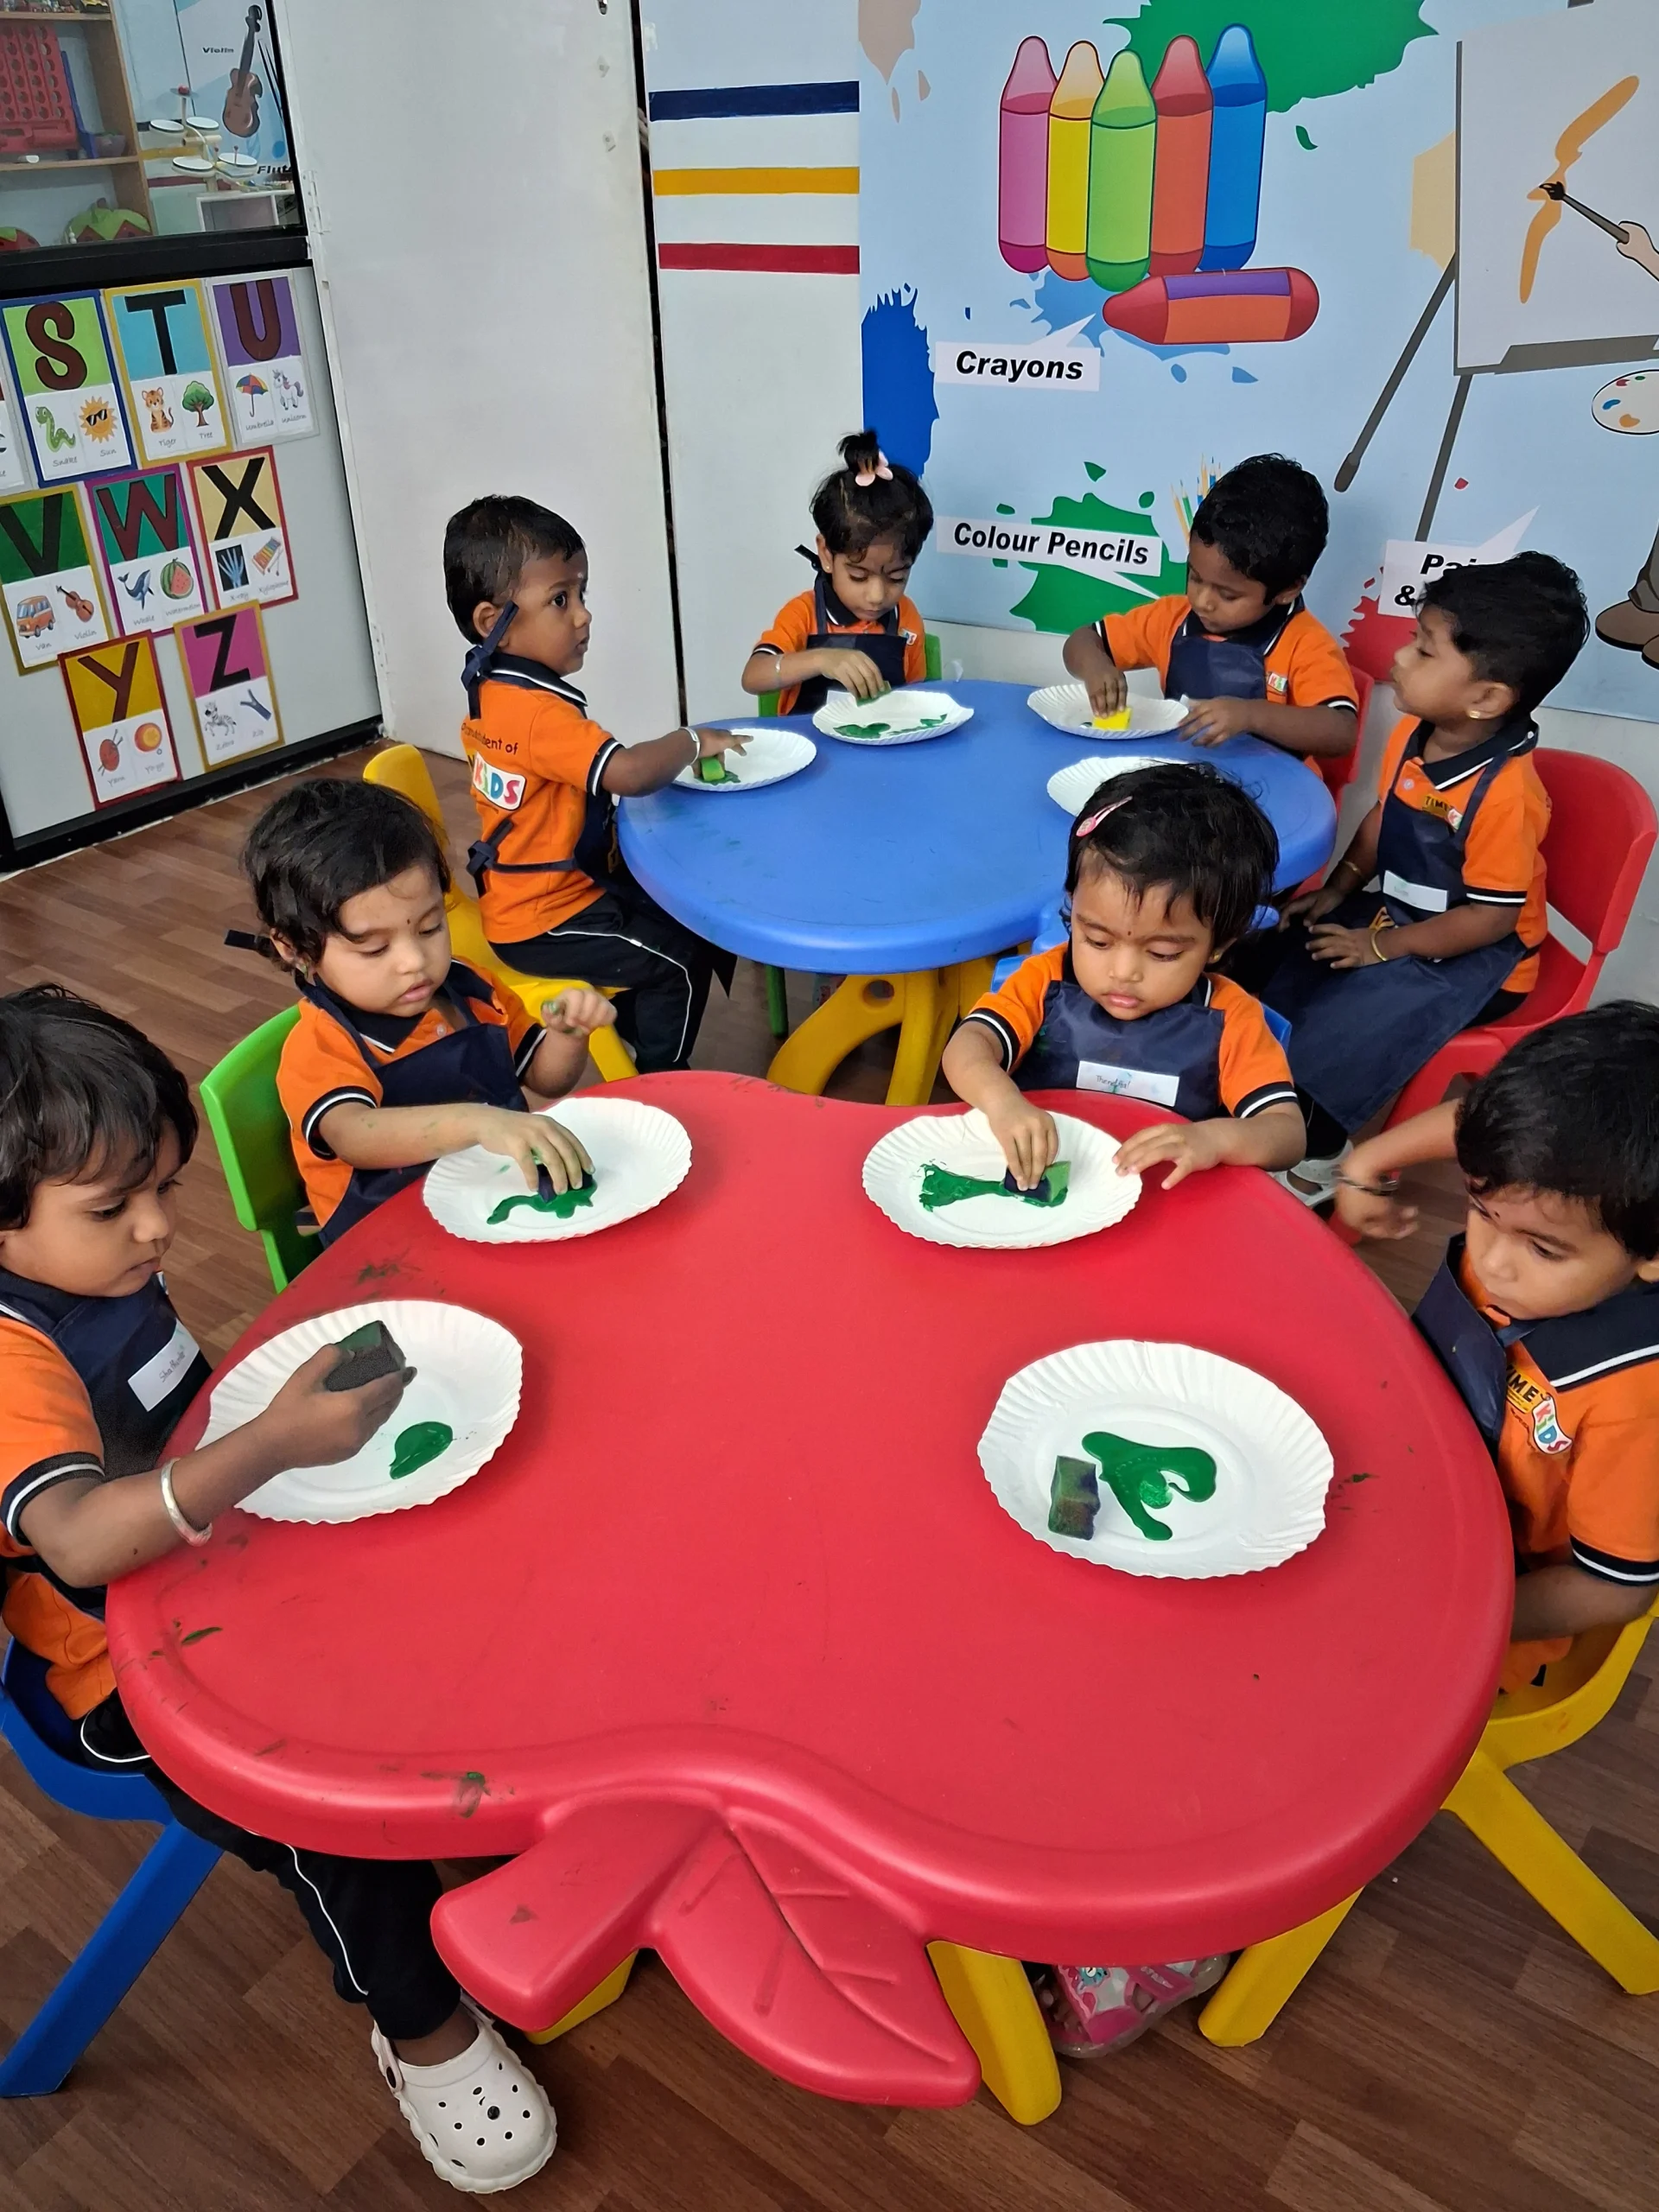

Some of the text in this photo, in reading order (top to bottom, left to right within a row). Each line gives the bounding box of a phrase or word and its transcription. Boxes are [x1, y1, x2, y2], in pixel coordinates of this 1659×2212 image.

[25, 301, 88, 391] S
[124, 289, 187, 375] T
[229, 279, 282, 362] U
[956, 350, 1084, 383] Crayons
[53, 456, 78, 467] Snake
[99, 448, 117, 457] Sun
[158, 438, 176, 448] Tiger
[96, 474, 178, 562] W
[201, 456, 276, 540] X
[0, 493, 63, 577] V
[954, 522, 1148, 565] Colour Pencils
[1394, 585, 1415, 606] &
[74, 630, 97, 640] Violin
[194, 613, 251, 692] Z
[77, 641, 140, 722] Y
[505, 742, 518, 755] of
